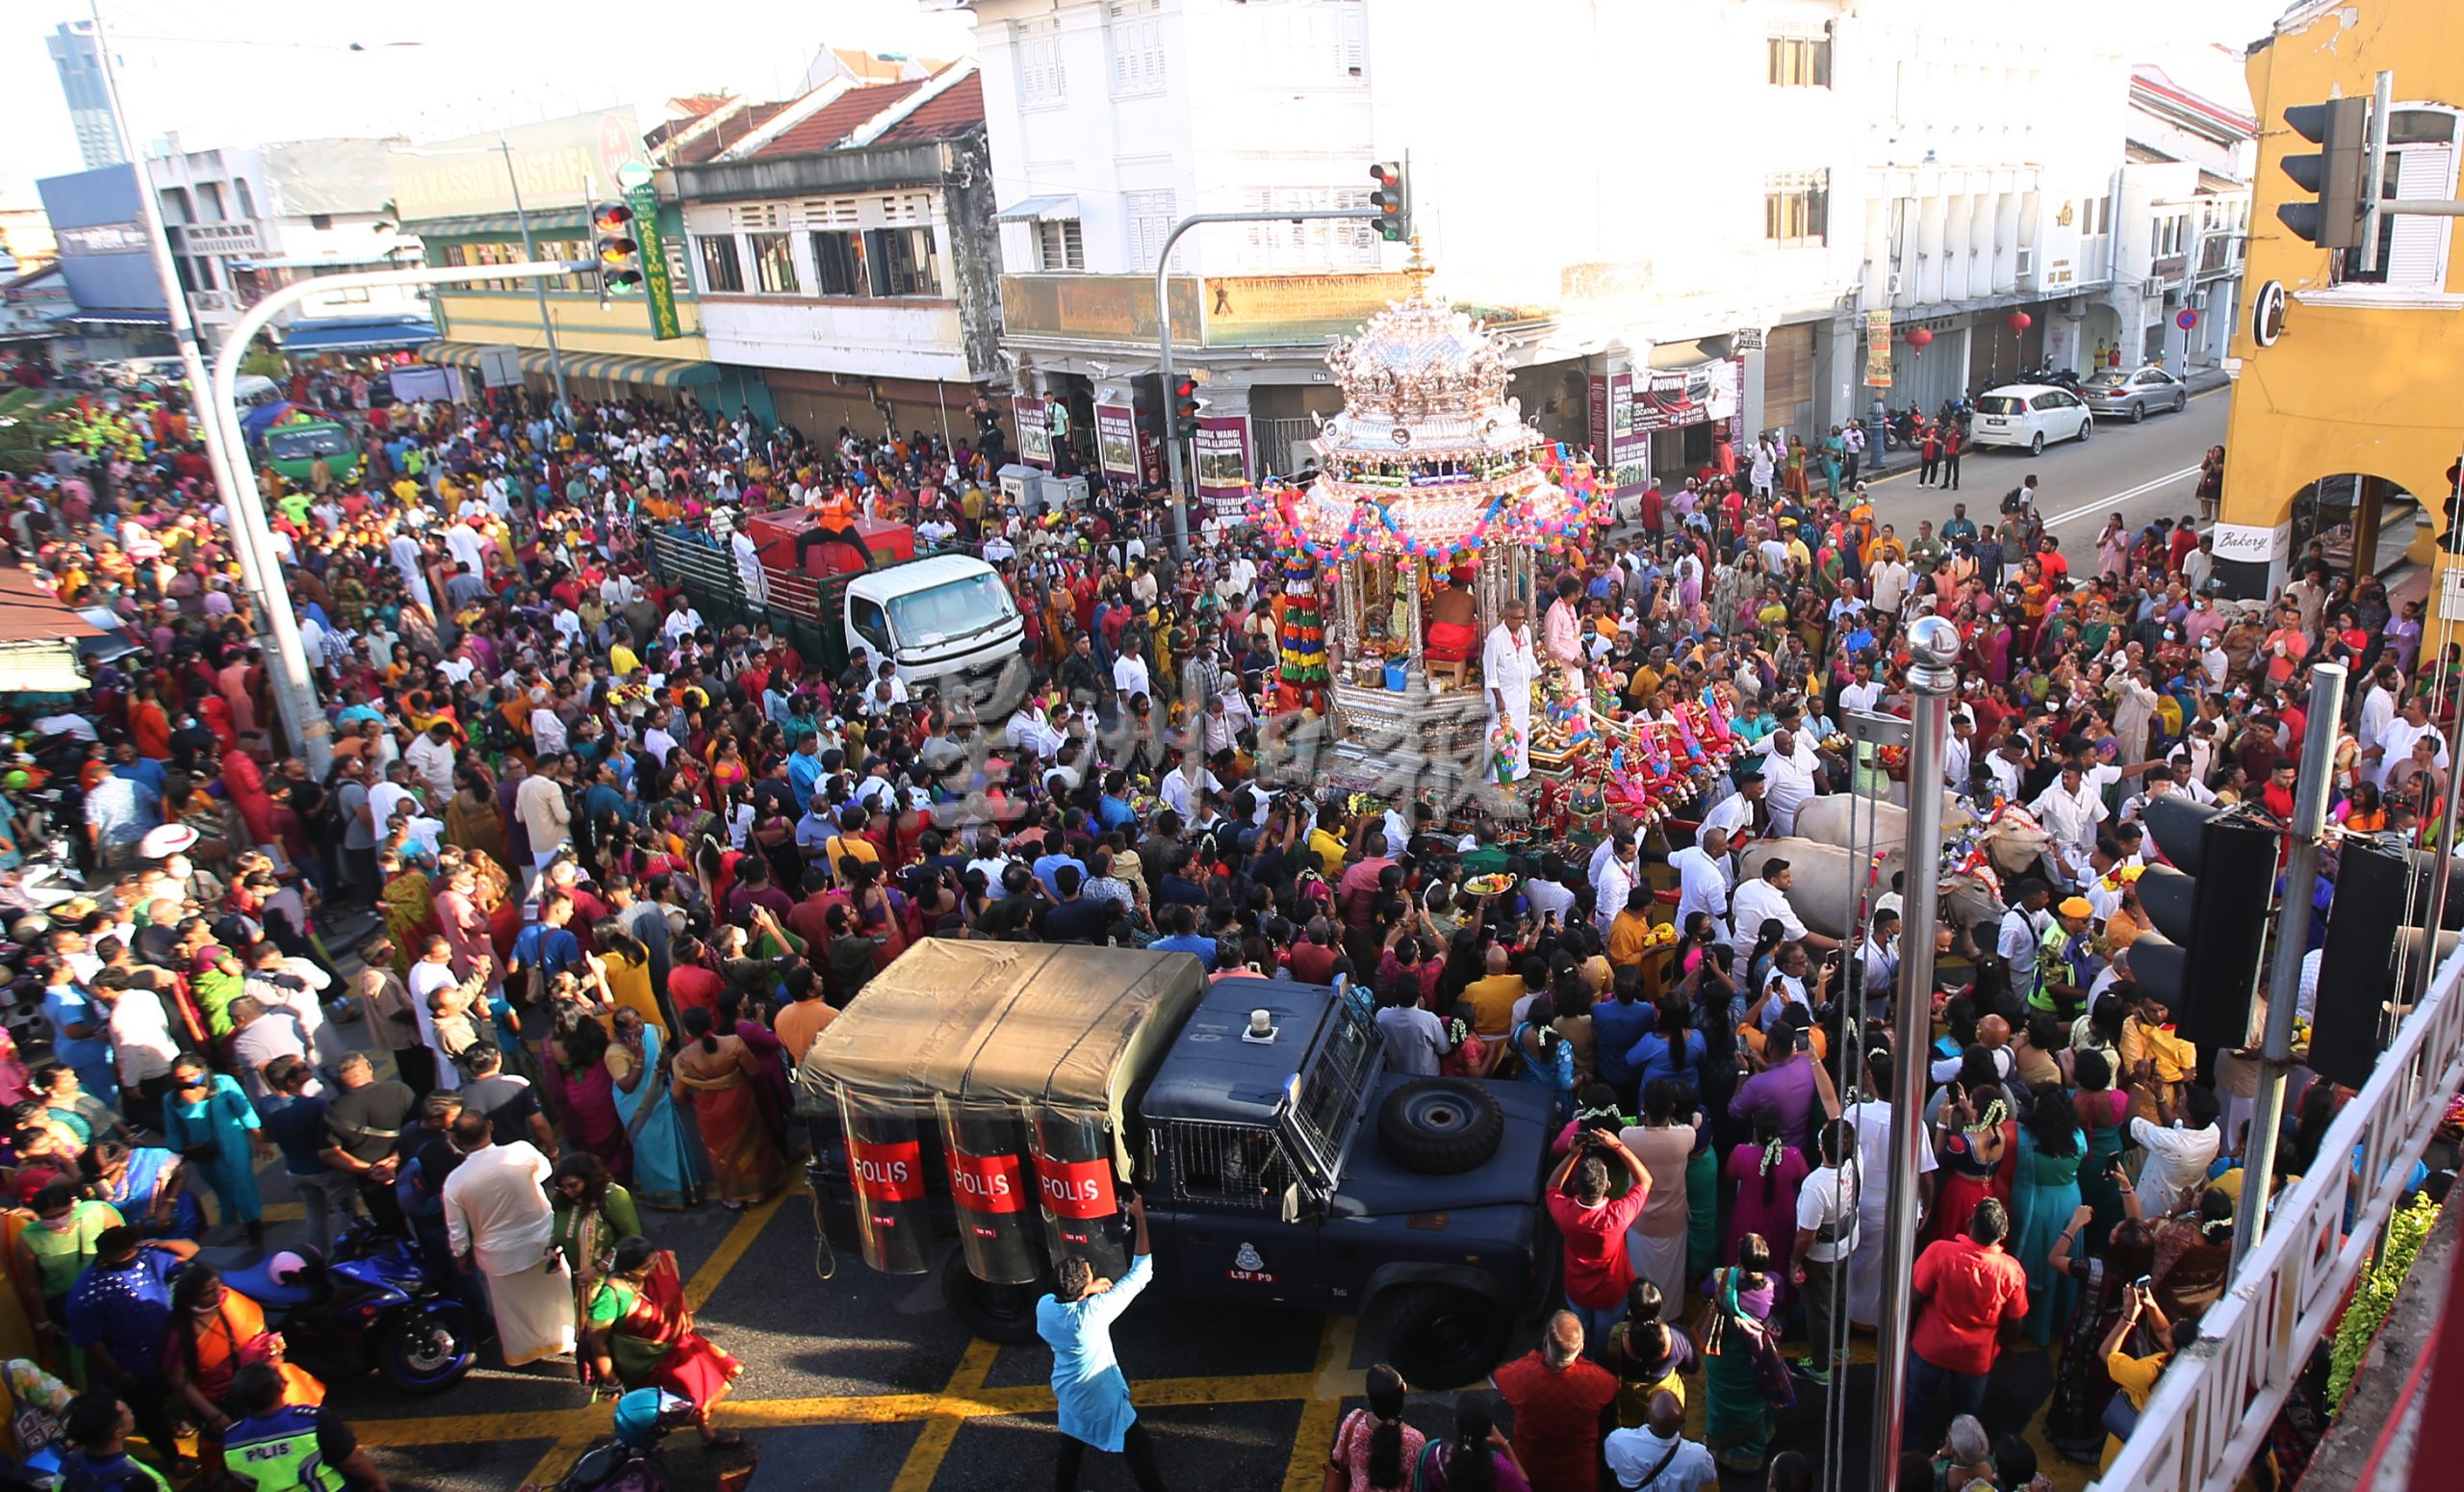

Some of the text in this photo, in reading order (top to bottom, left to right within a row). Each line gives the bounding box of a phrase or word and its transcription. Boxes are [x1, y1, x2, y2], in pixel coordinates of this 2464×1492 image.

[426, 162, 496, 204] KASSIM
[495, 146, 599, 198] MUSTAFA
[639, 219, 664, 272] KASSIM
[1318, 276, 1345, 290] SONS
[650, 276, 677, 337] MUSTAFA
[1652, 376, 1684, 392] MOVING
[1196, 428, 1240, 438] MINYAK WANGI
[1211, 438, 1243, 448] ALKOHOL
[2218, 531, 2270, 553] Bakery
[855, 1157, 909, 1184] POLIS
[953, 1169, 1010, 1196] POLIS
[1040, 1174, 1099, 1200] POLIS
[1231, 1271, 1272, 1282] LSF P9
